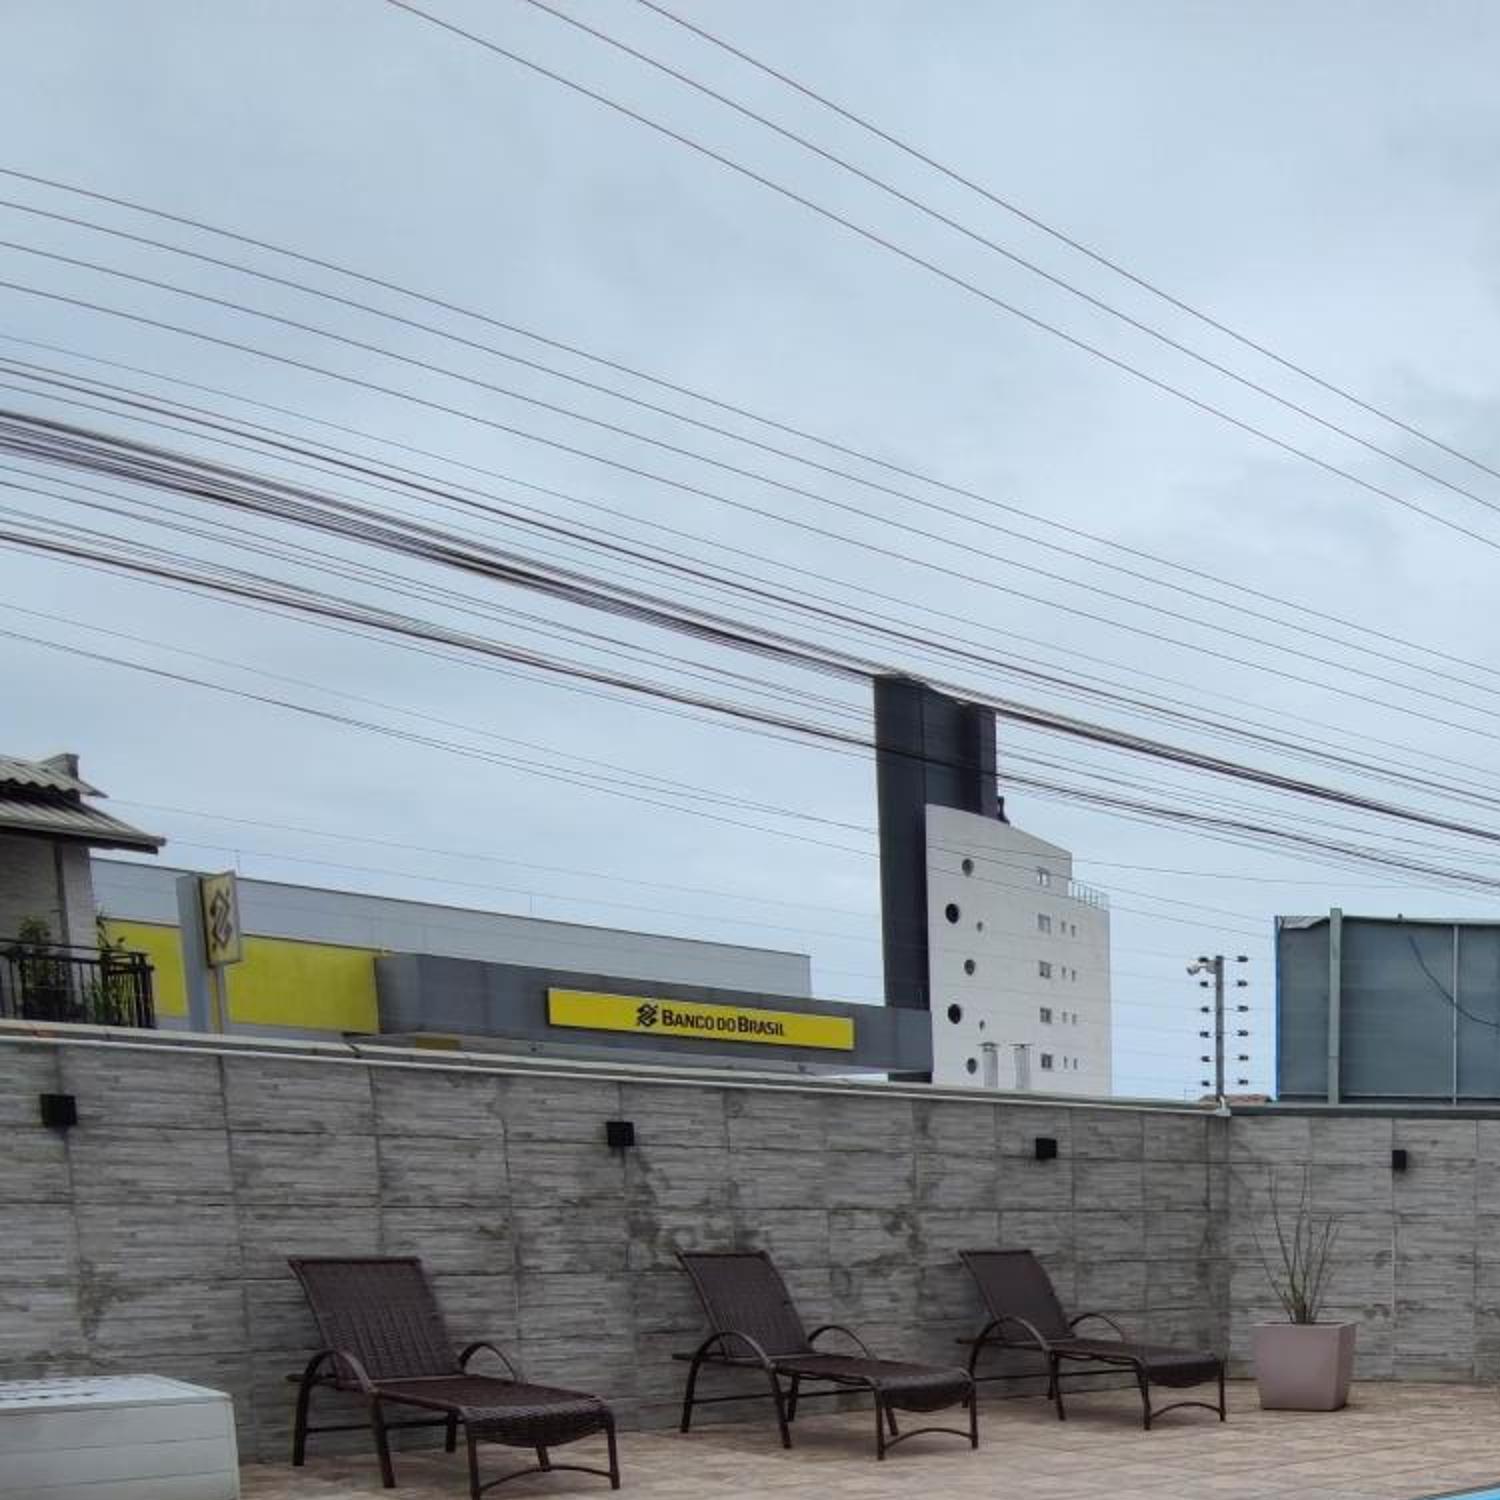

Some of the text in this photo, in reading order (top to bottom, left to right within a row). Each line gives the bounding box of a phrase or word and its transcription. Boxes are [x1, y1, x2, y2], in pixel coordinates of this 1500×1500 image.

[661, 1009, 785, 1036] BANCO DO BRASIL
